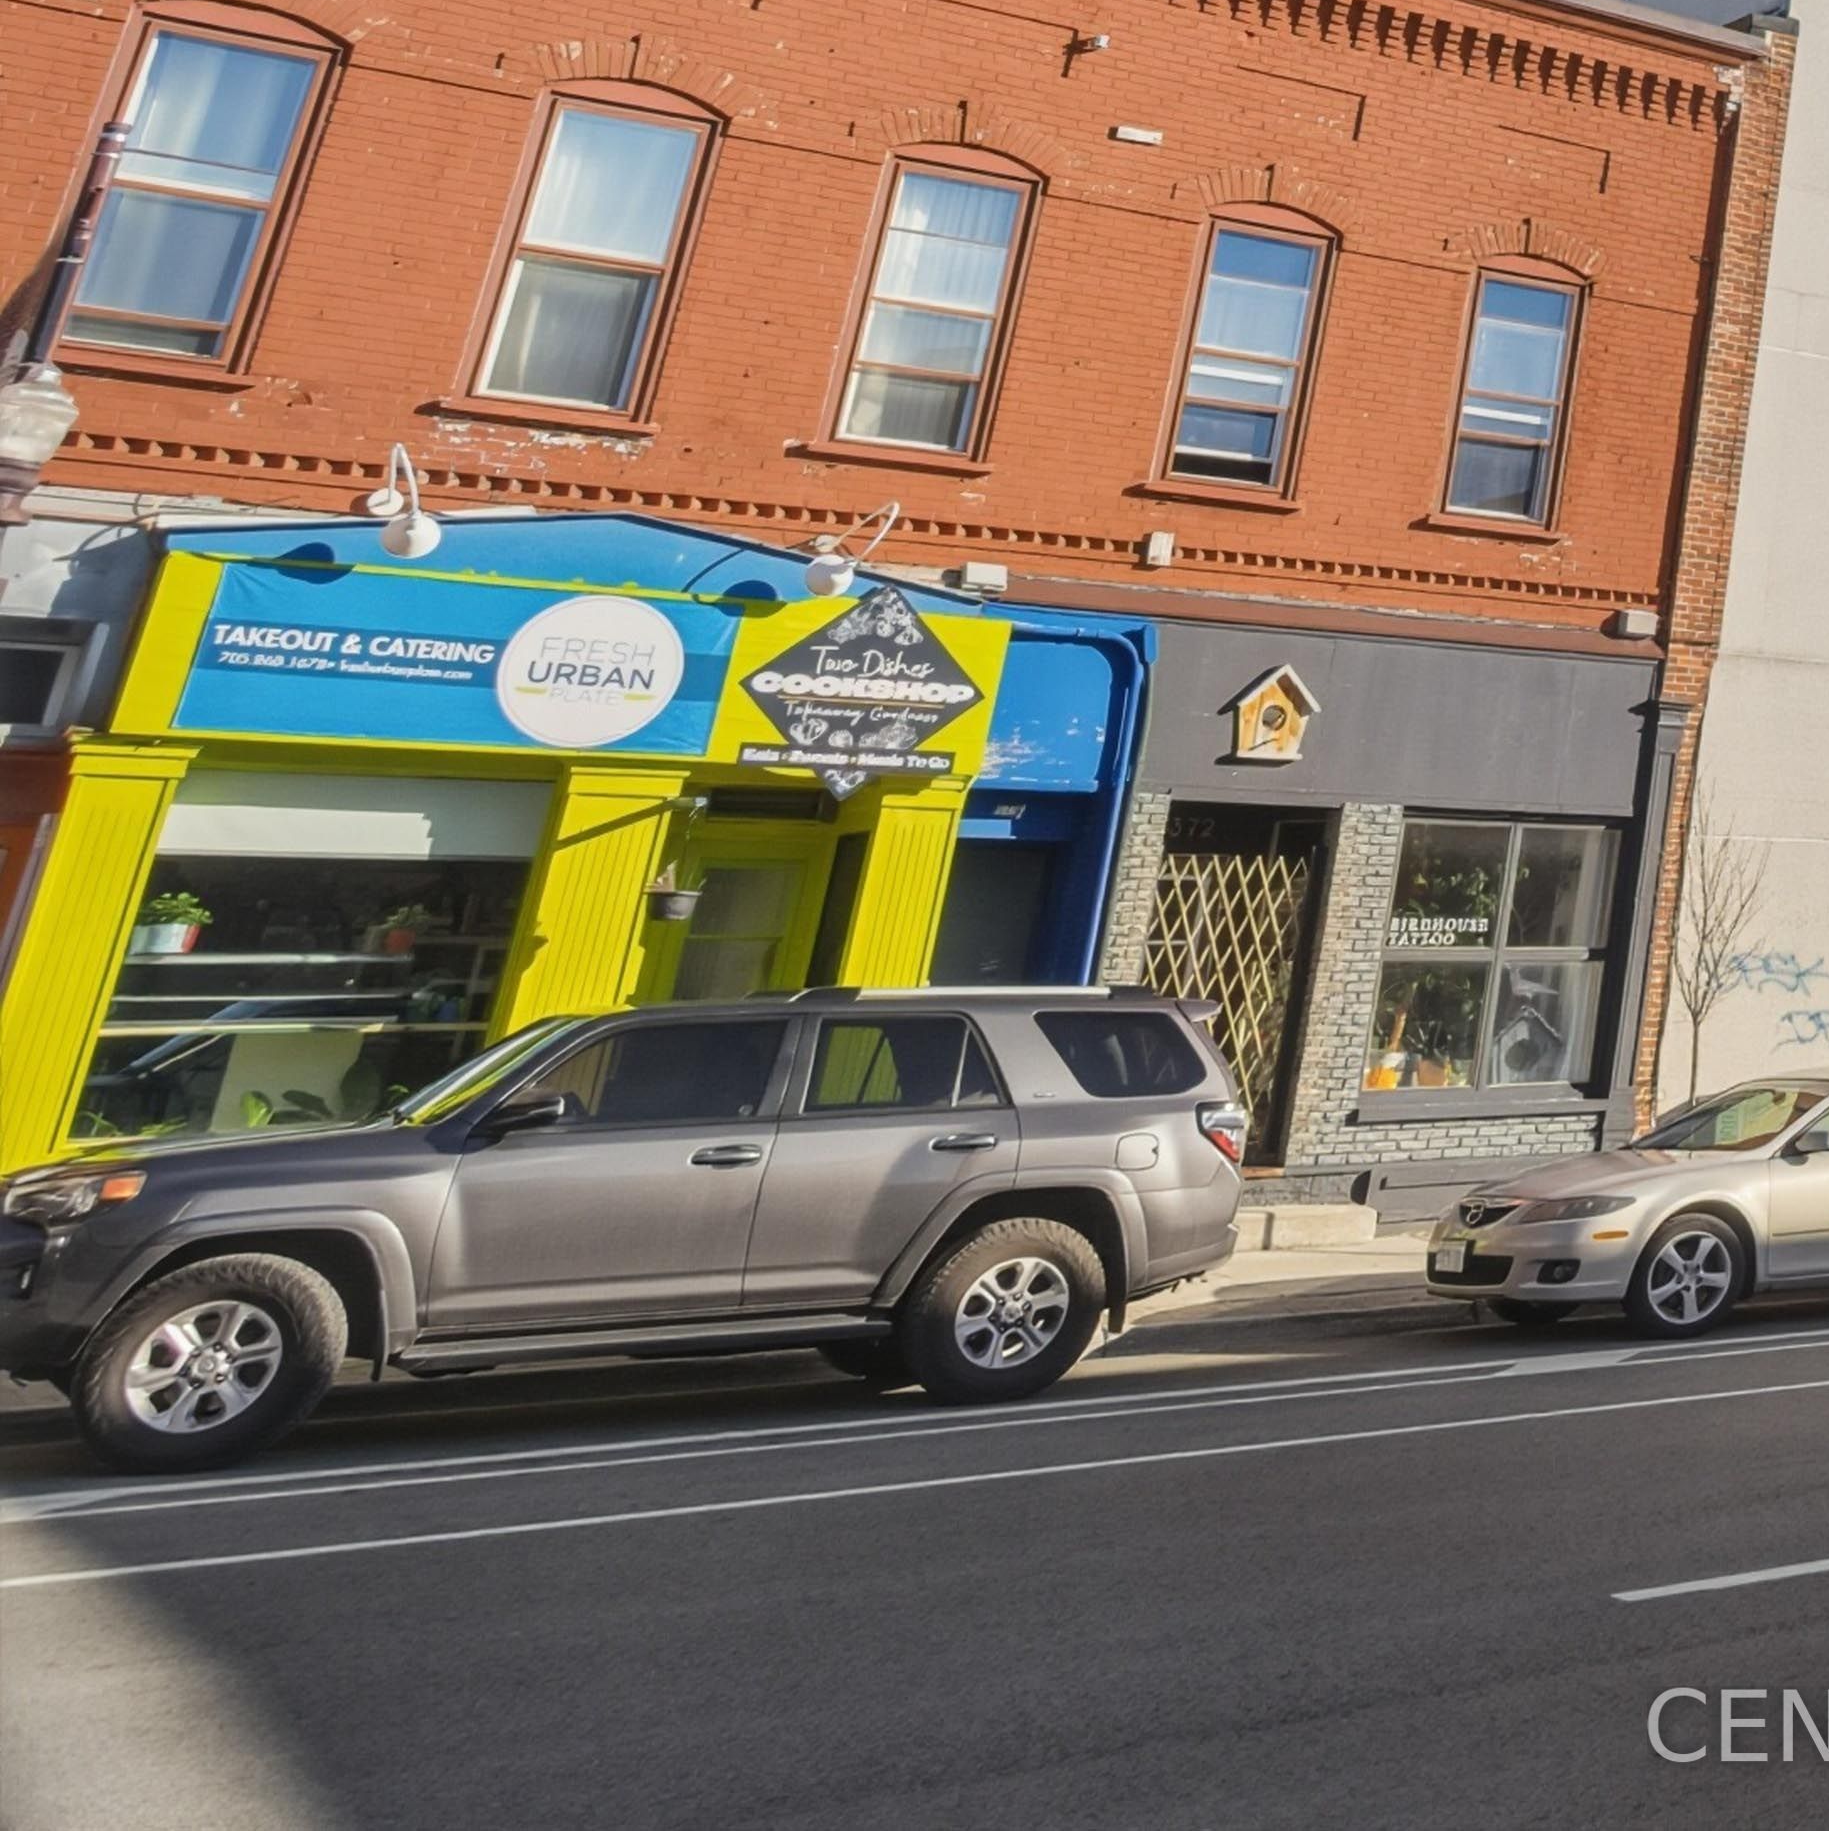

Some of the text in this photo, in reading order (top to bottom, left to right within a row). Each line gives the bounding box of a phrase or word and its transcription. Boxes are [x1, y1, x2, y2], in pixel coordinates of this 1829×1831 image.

[214, 624, 496, 664] TAKEOUT & CATERING
[540, 636, 656, 666] FRESH
[527, 660, 654, 690] URBAN
[811, 645, 935, 678] Two Dishes
[549, 687, 620, 706] PLATE
[751, 671, 976, 705] COOKSHOP
[1389, 932, 1456, 946] TATTOO
[1390, 917, 1489, 933] BIRDHOUSE
